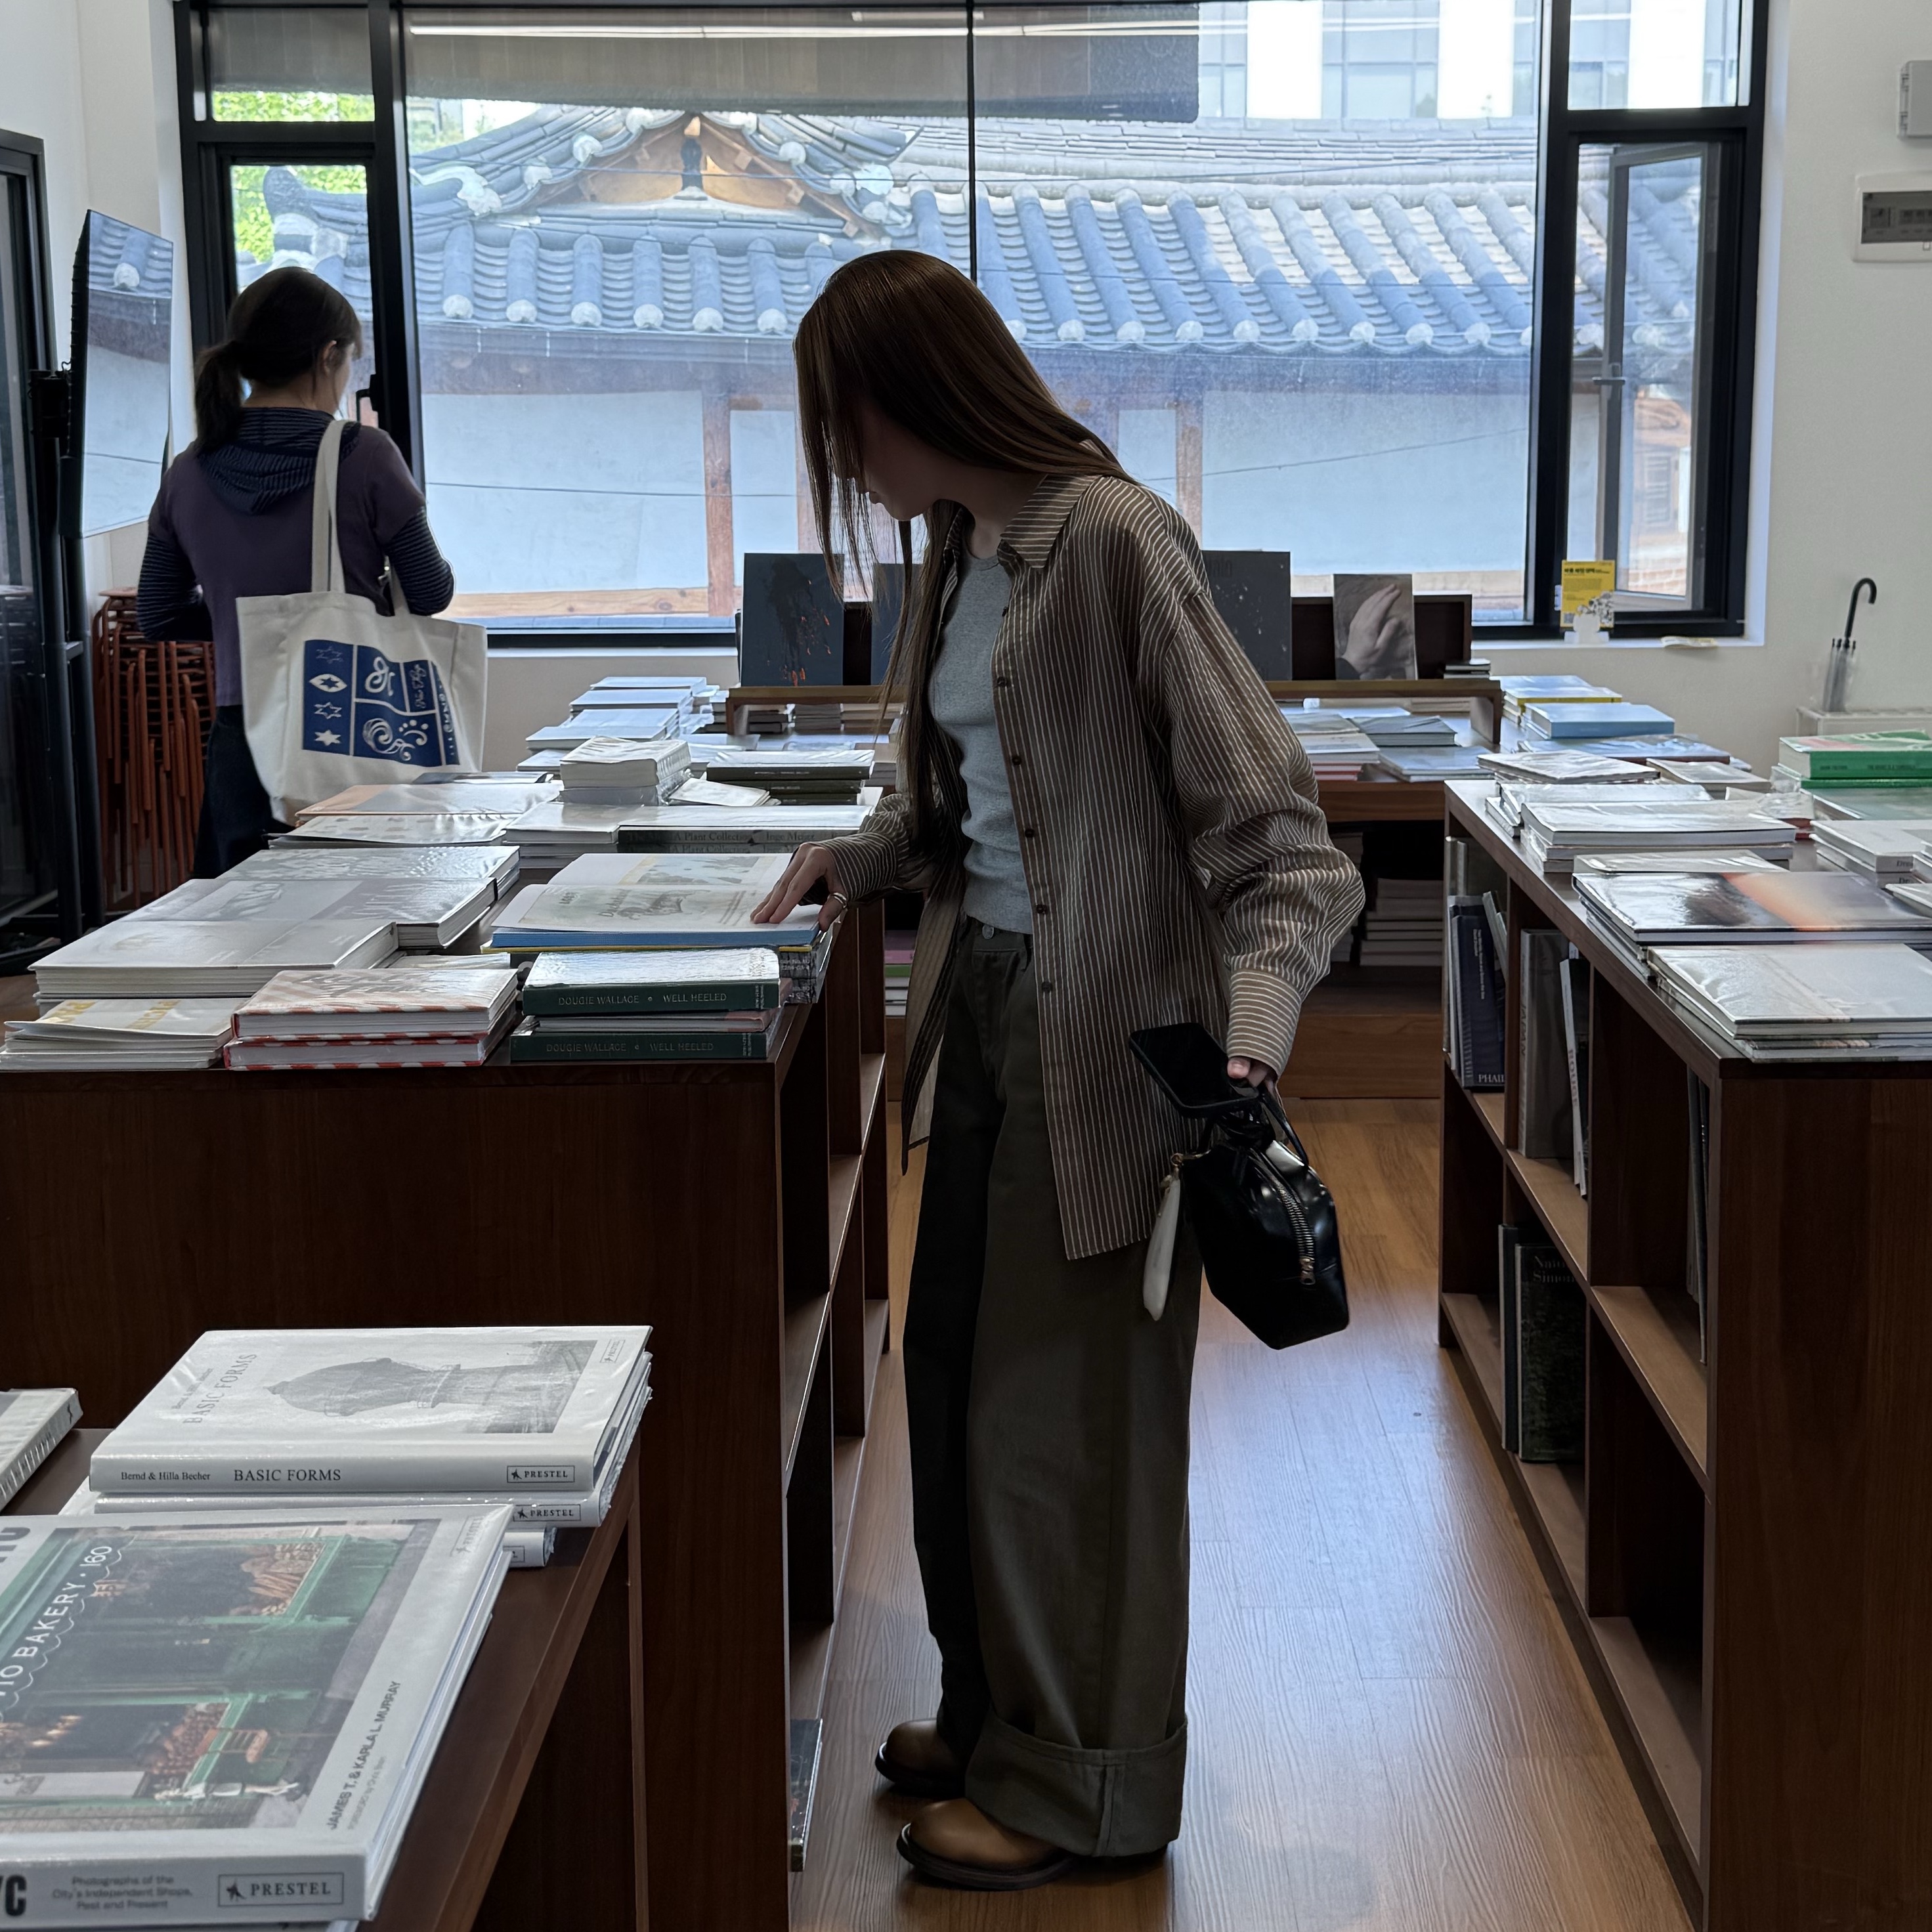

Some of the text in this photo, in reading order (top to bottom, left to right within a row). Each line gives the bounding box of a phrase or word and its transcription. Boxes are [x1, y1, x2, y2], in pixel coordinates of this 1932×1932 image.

[685, 832, 706, 841] Plant
[558, 993, 727, 1006] DOUGIE WALLACE WELL HEELED
[546, 1043, 582, 1052] DOUGIE
[584, 1042, 626, 1051] WALLACE
[649, 1042, 675, 1051] WELL
[182, 1392, 225, 1424] BASIC
[213, 1354, 257, 1388] FORMS
[121, 1469, 341, 1482] Bernd & Hilla Becher BASIC FORMS
[524, 1470, 569, 1478] PRESTEL
[530, 1509, 574, 1518] PRESTEL
[12, 1581, 86, 1658] BAKERY
[79, 1545, 113, 1567] 160
[374, 1681, 401, 1723] MURRAY
[250, 1882, 332, 1897] PRESTEL
